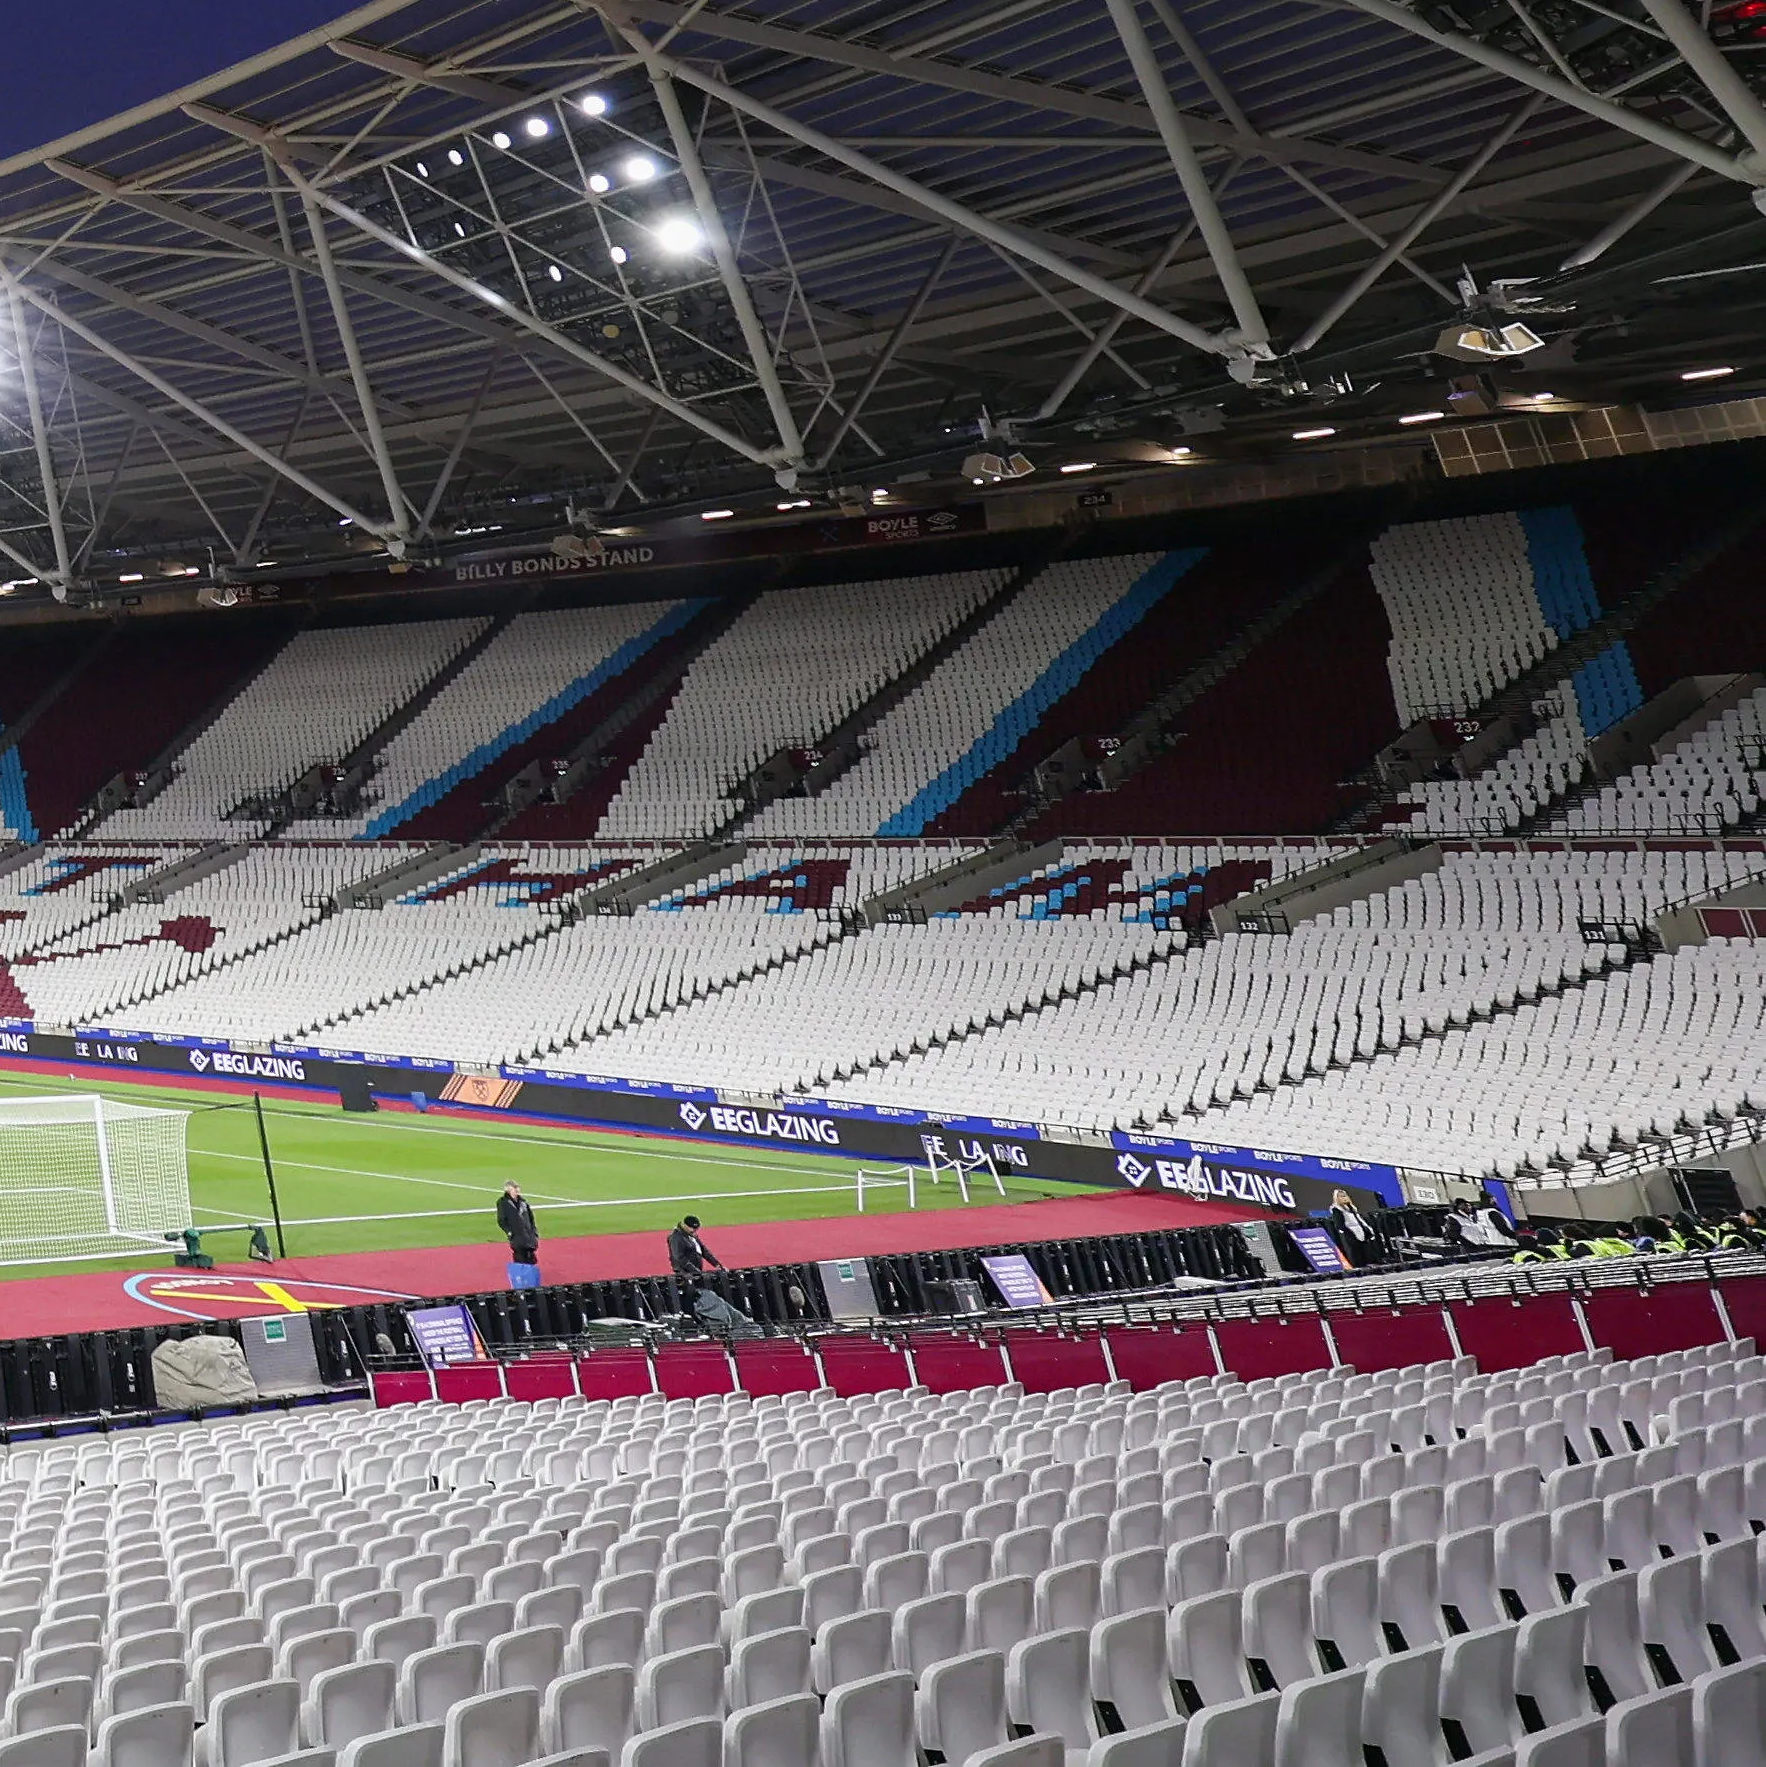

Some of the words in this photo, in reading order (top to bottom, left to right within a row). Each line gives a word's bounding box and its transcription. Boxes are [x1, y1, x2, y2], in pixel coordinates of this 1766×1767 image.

[868, 515, 919, 533] BOYLE
[455, 562, 507, 581] BILLY
[512, 555, 583, 575] BONDS
[587, 547, 655, 568] STAND
[212, 1052, 305, 1080] EEGLAZING
[709, 1105, 840, 1145] EEGLAZING
[1129, 1134, 1155, 1146] BOYLE
[1191, 1142, 1219, 1153] BOYLE
[1254, 1150, 1282, 1162] BOYLE
[1320, 1158, 1350, 1170] BOYLE
